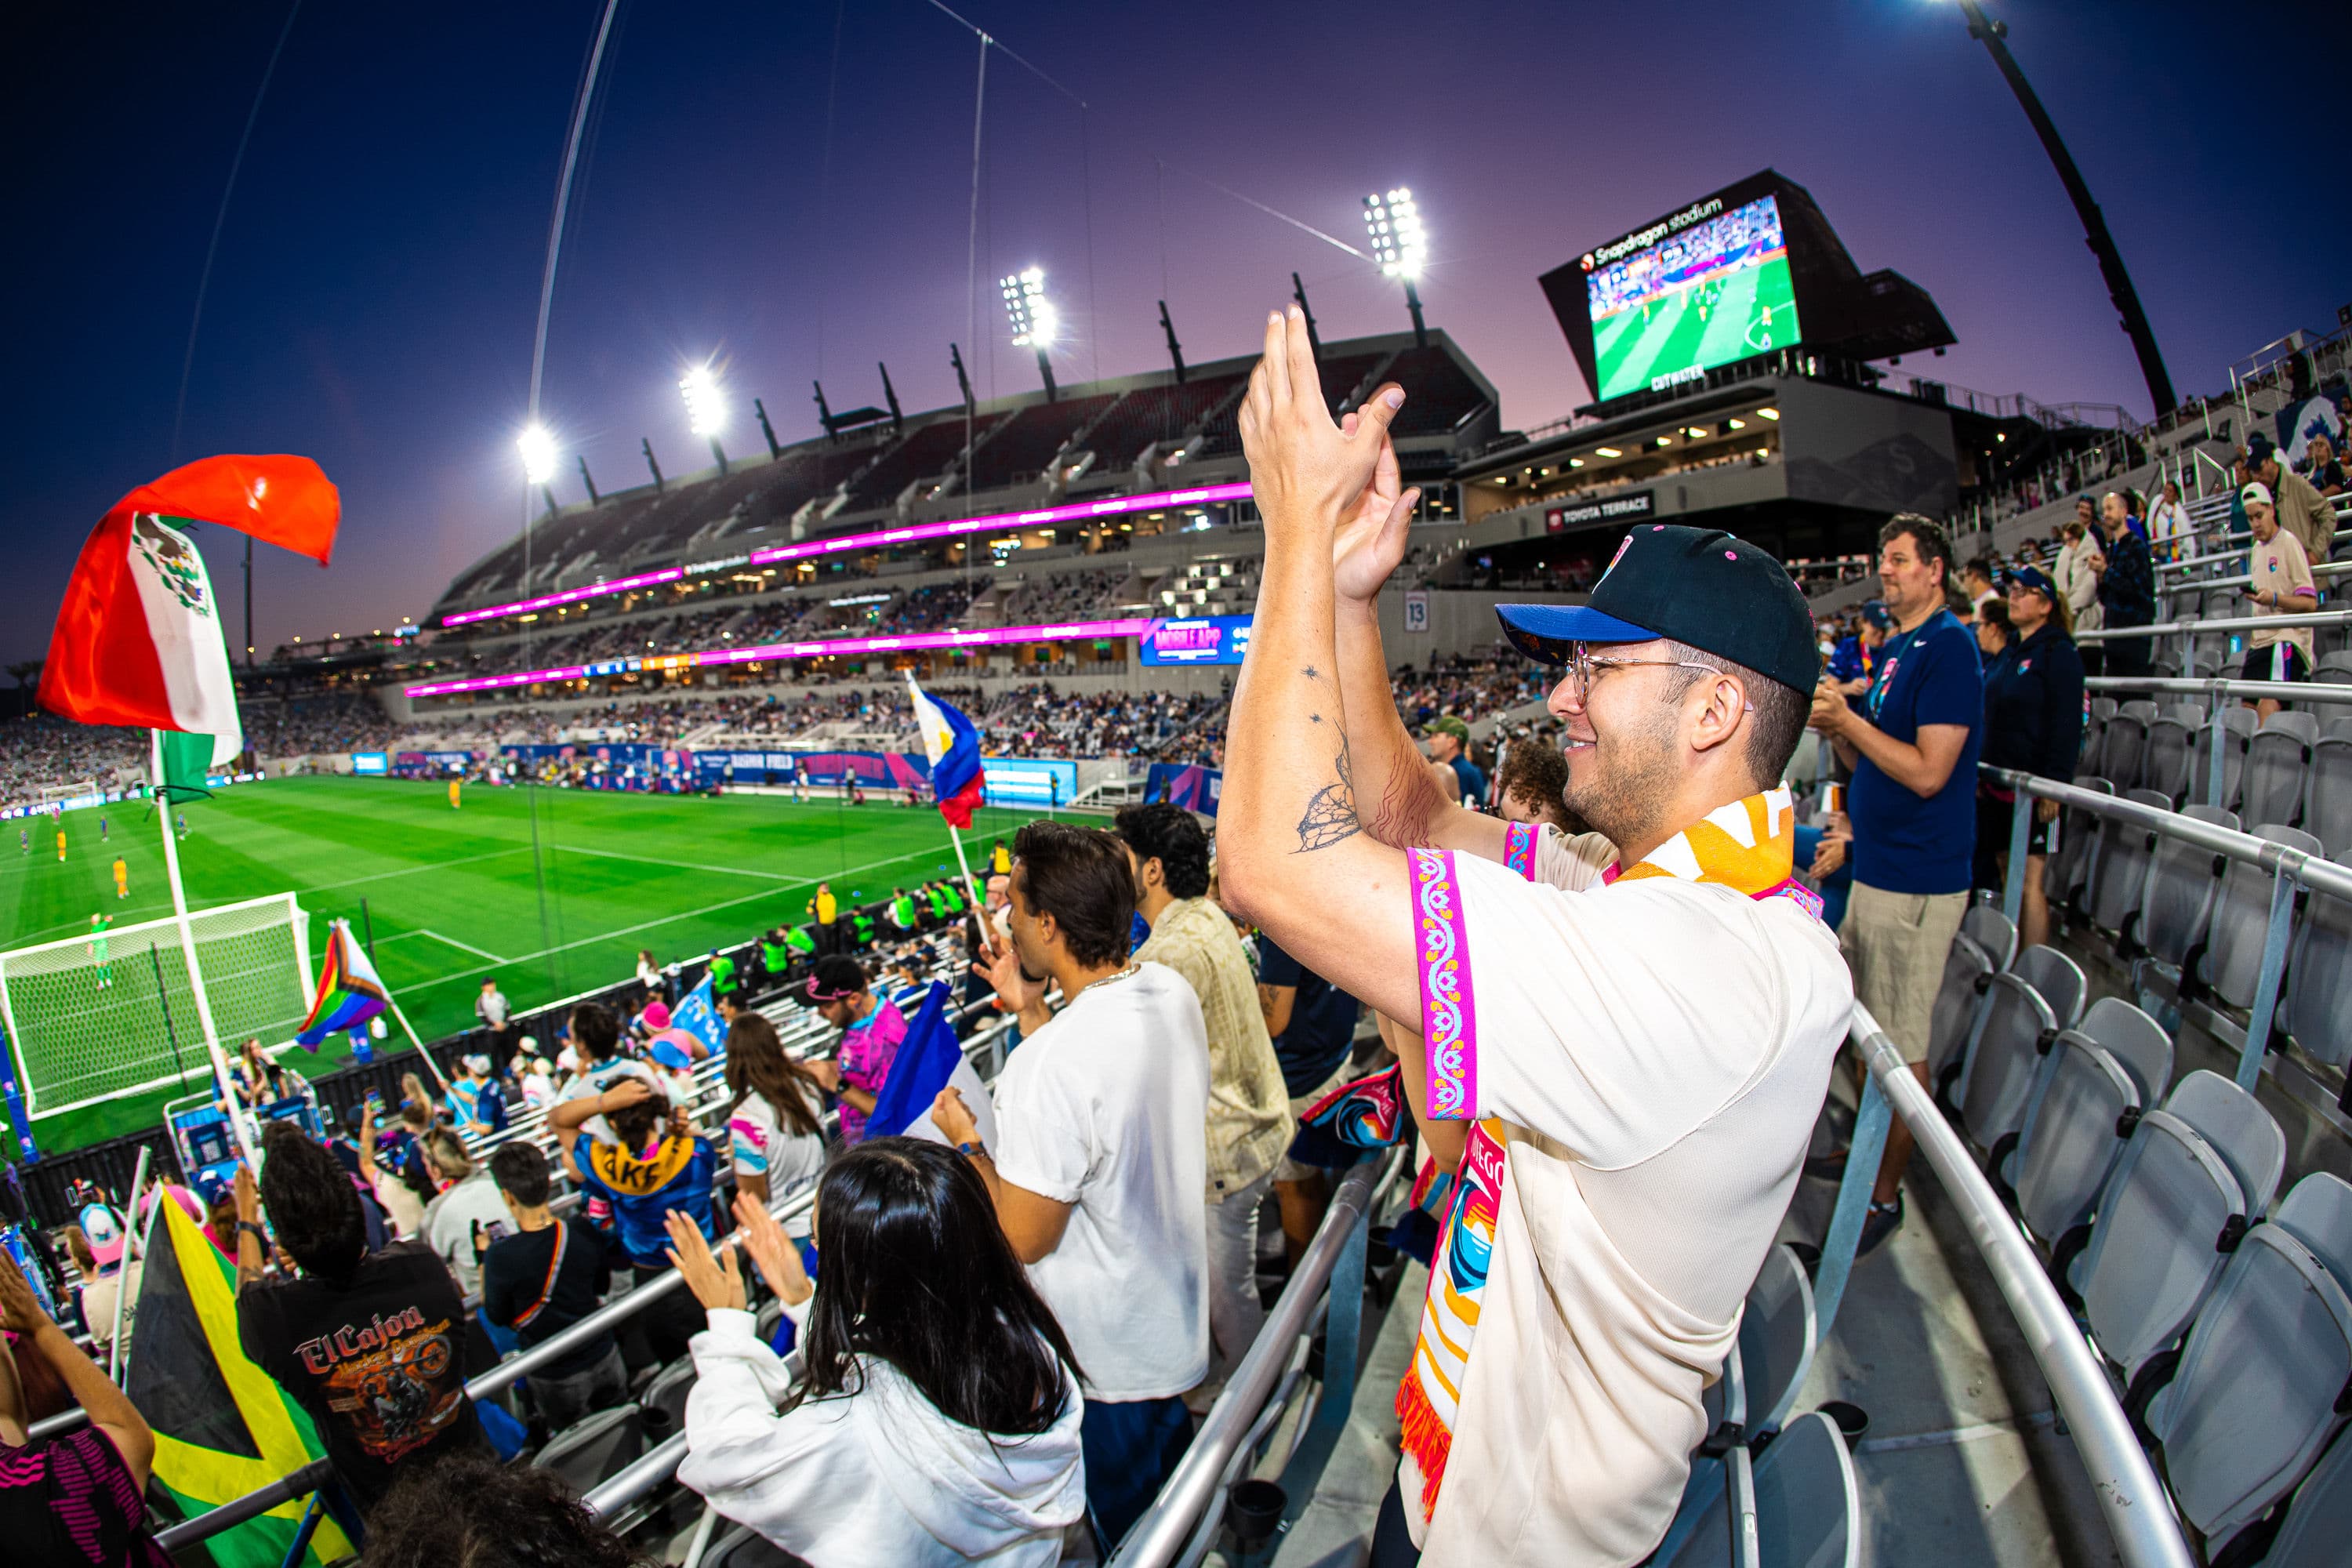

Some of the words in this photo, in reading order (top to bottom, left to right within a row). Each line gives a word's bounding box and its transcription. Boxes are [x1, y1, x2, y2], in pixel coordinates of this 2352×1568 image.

[1595, 223, 1668, 265] Snapdragon
[1668, 198, 1722, 231] stadium
[1563, 506, 1601, 524] TOYOTA
[1600, 496, 1650, 517] TERRACE
[1409, 602, 1425, 623] 13
[1197, 626, 1222, 649] APP
[292, 1334, 339, 1374] El
[334, 1306, 426, 1357] Cajon
